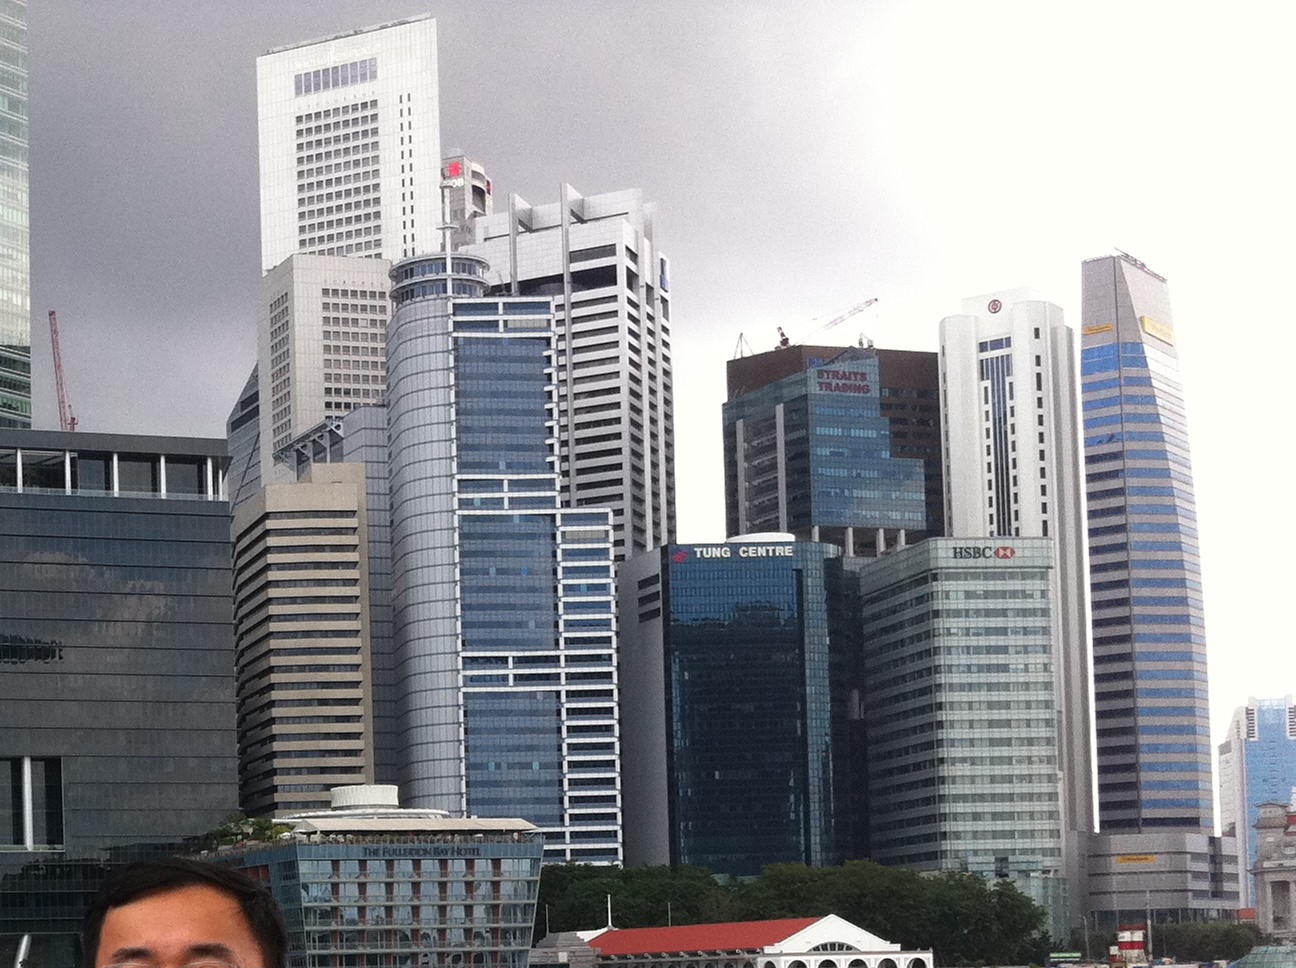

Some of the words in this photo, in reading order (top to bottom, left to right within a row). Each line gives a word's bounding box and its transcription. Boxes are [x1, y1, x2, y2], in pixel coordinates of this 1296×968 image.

[816, 369, 868, 382] STRAITS
[816, 381, 872, 394] TRADING
[693, 547, 732, 559] TUNG
[738, 545, 794, 558] CENTRE
[952, 546, 993, 559] HSBC
[363, 847, 381, 857] THE
[383, 847, 432, 857] FULLERTON
[433, 847, 449, 857] BAY
[450, 847, 482, 857] HOTEL
